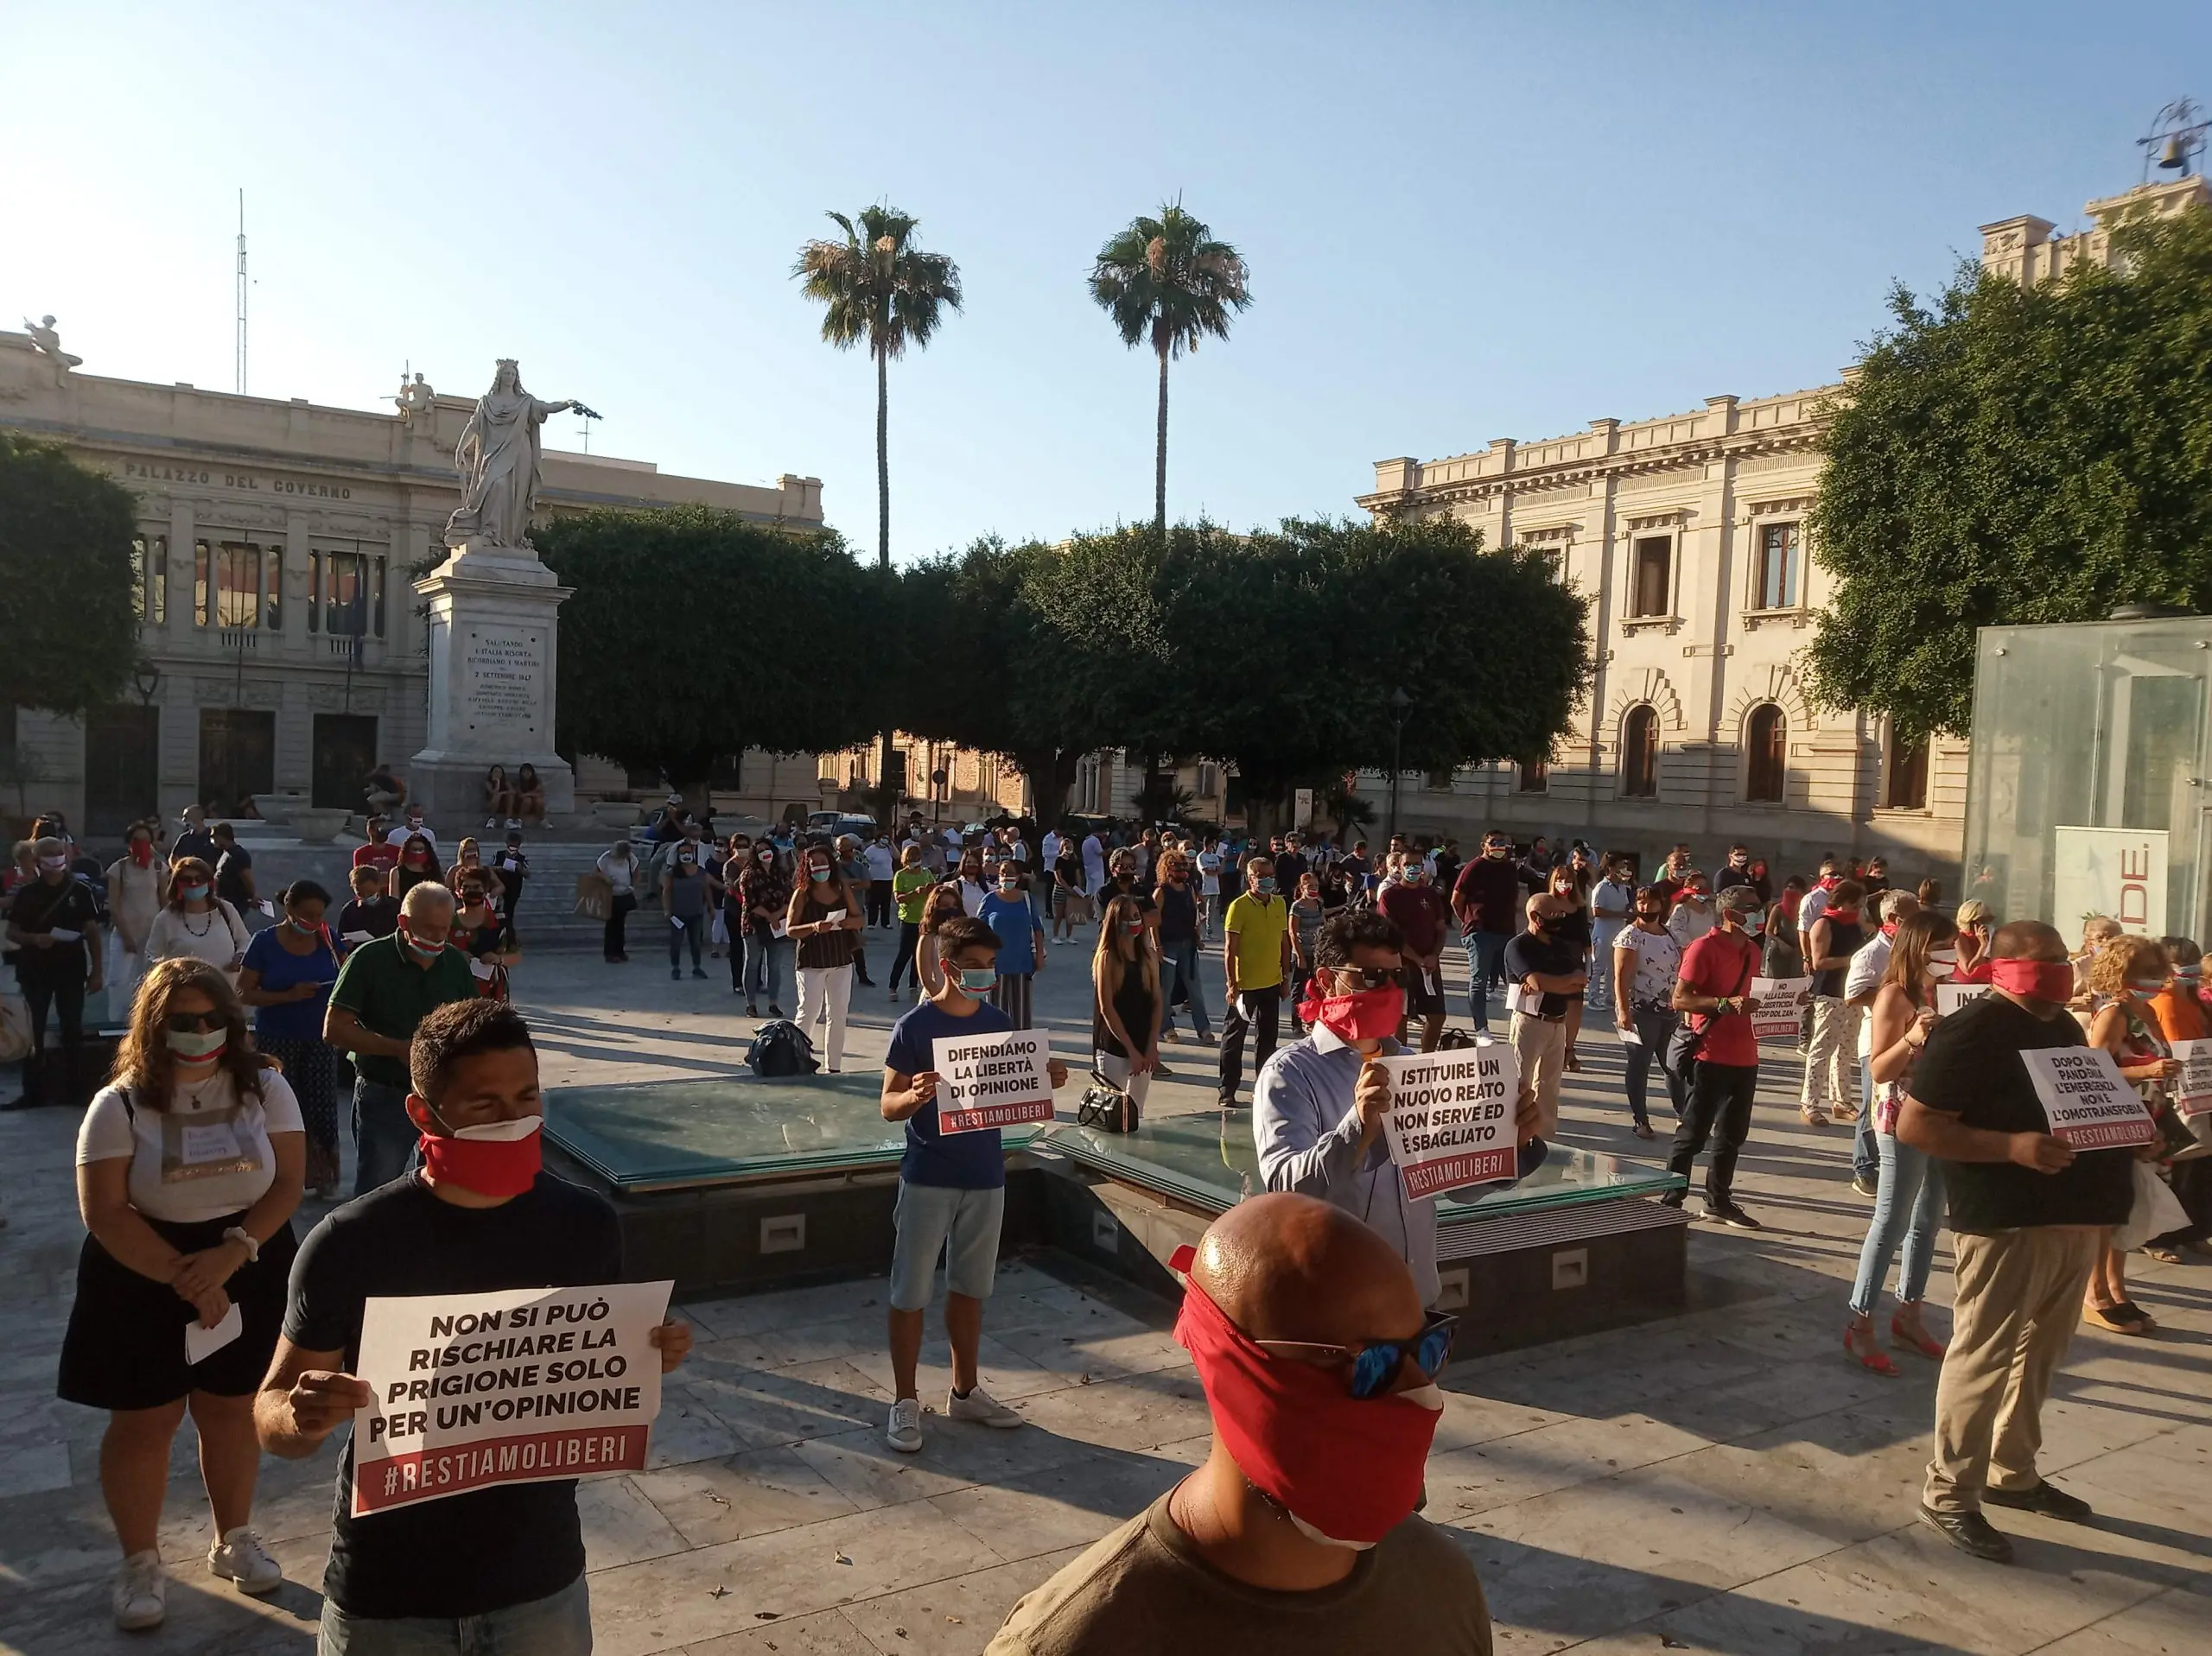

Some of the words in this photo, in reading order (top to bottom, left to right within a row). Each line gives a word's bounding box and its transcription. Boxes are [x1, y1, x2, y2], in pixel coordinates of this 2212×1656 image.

[126, 464, 209, 484] PALAZZO
[225, 475, 257, 489] DEL
[274, 480, 351, 499] GOVERNO
[475, 648, 502, 657] LITALIA
[948, 1041, 1037, 1062] DIFENDIAMO
[2051, 1056, 2082, 1068] DOPO
[955, 1066, 973, 1080] LA
[976, 1056, 1033, 1077] LIBERTÀ
[1401, 1063, 1475, 1086] ISTITUIRE
[1479, 1059, 1499, 1076] UN
[2058, 1069, 2105, 1080] PANDEMIA
[950, 1085, 964, 1099] DI
[969, 1077, 1039, 1096] OPINIONE
[1394, 1088, 1452, 1109] NUOVO
[1456, 1082, 1505, 1101] REATO
[2055, 1082, 2119, 1094] L'EMERGENZA
[950, 1104, 1045, 1128] #RESTIAMOLIBERI
[1394, 1113, 1427, 1132] NON
[1432, 1107, 1481, 1126] SERVE
[1484, 1104, 1504, 1120] ED
[2052, 1104, 2145, 1121] L'OMOTRANSFOBIA
[1402, 1134, 1410, 1154] È
[1413, 1126, 1496, 1152] SBAGLIATO
[1408, 1154, 1503, 1192] #RESTIAMOLIBERI
[430, 1310, 503, 1339] NON
[508, 1306, 536, 1328] SI
[545, 1297, 610, 1326] PUÒ
[410, 1331, 575, 1372] RISCHIARE
[582, 1328, 617, 1350] LA
[387, 1365, 539, 1405] PRIGIONE
[545, 1355, 626, 1383] SOLO
[370, 1411, 428, 1443] PER
[436, 1386, 640, 1431] UN'OPINIONE
[384, 1434, 626, 1496] #RESTIAMOLIBERI
